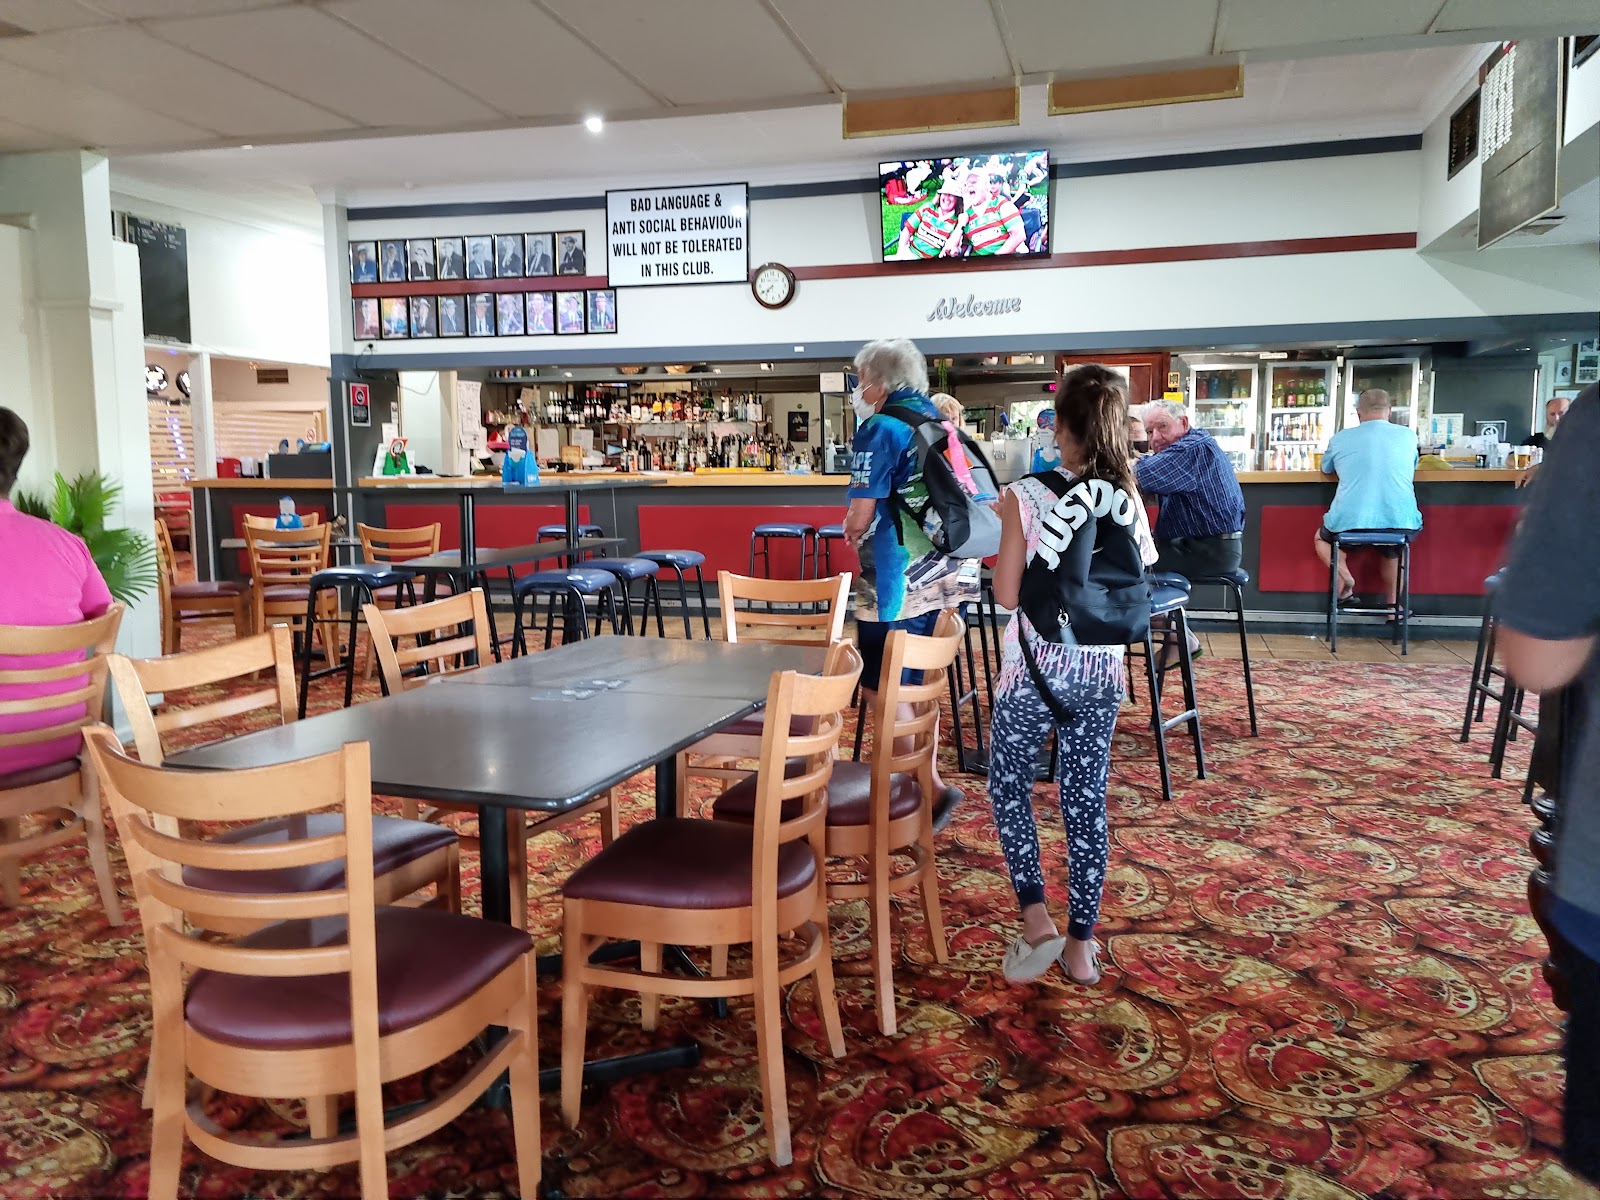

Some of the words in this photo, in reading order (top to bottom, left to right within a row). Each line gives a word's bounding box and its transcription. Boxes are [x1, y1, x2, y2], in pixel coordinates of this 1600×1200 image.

[630, 197, 651, 212] BAD
[655, 193, 710, 211] LANGUAGE
[714, 192, 722, 207] &
[612, 221, 636, 235] ANTI
[639, 218, 677, 234] SOCIAL
[680, 215, 742, 232] BEHAVIOUR
[612, 242, 638, 257] WILL
[641, 241, 661, 256] NOT
[665, 240, 678, 254] BE
[681, 237, 742, 253] TOLERATED
[641, 263, 652, 277] IN
[655, 262, 679, 277] THIS
[682, 261, 714, 276] CLUB.
[926, 293, 1022, 322] Welcome
